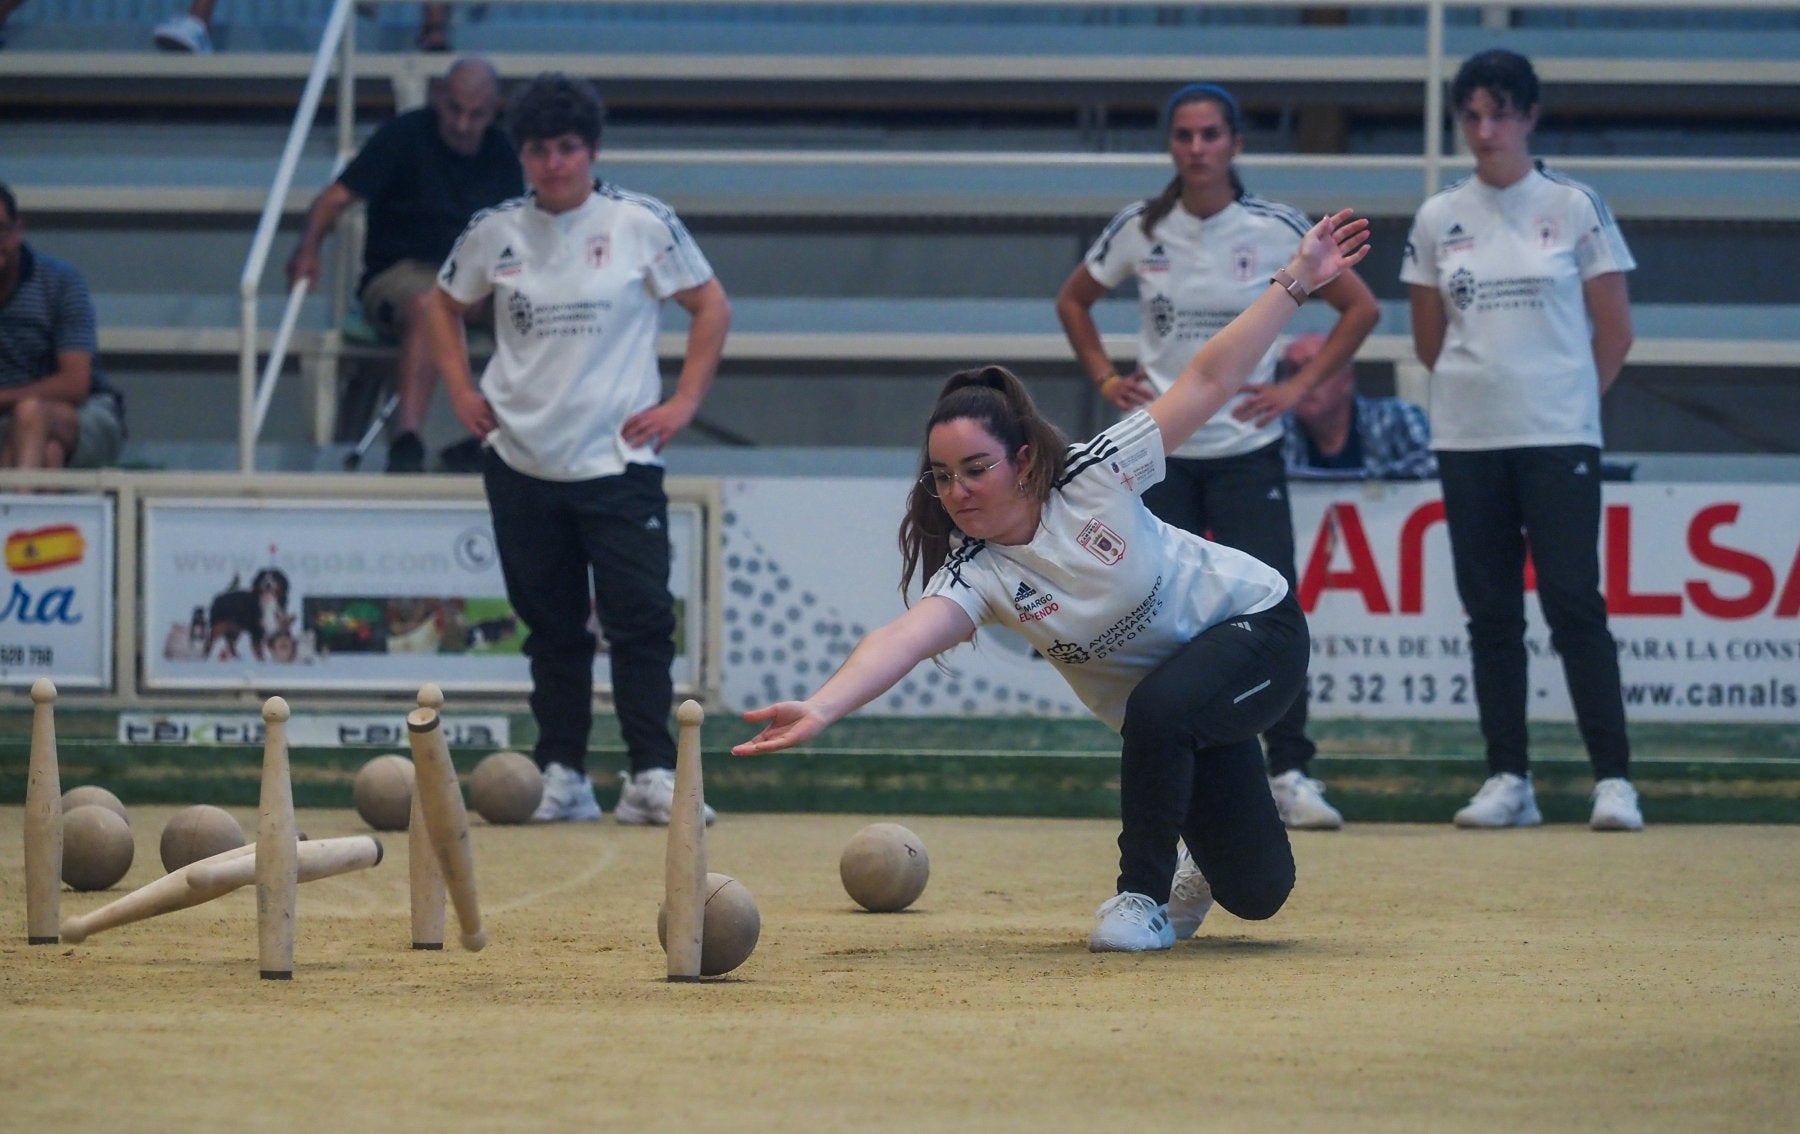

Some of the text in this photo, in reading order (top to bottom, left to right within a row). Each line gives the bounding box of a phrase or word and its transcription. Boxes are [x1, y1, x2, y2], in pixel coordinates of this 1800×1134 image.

[0, 580, 84, 625] ra
[1014, 593, 1053, 612] CMARGO
[1015, 588, 1037, 603] adidas
[1030, 602, 1059, 621] ENDO
[1089, 575, 1163, 650] AYUNTAMIENTO
[1097, 600, 1163, 660] DEPORTES
[1400, 636, 1427, 658] DE
[1686, 638, 1718, 659] LA
[1726, 638, 1800, 660] CONS
[1348, 673, 1387, 703] 32
[1402, 673, 1437, 703] 13
[1451, 673, 1470, 703] 2
